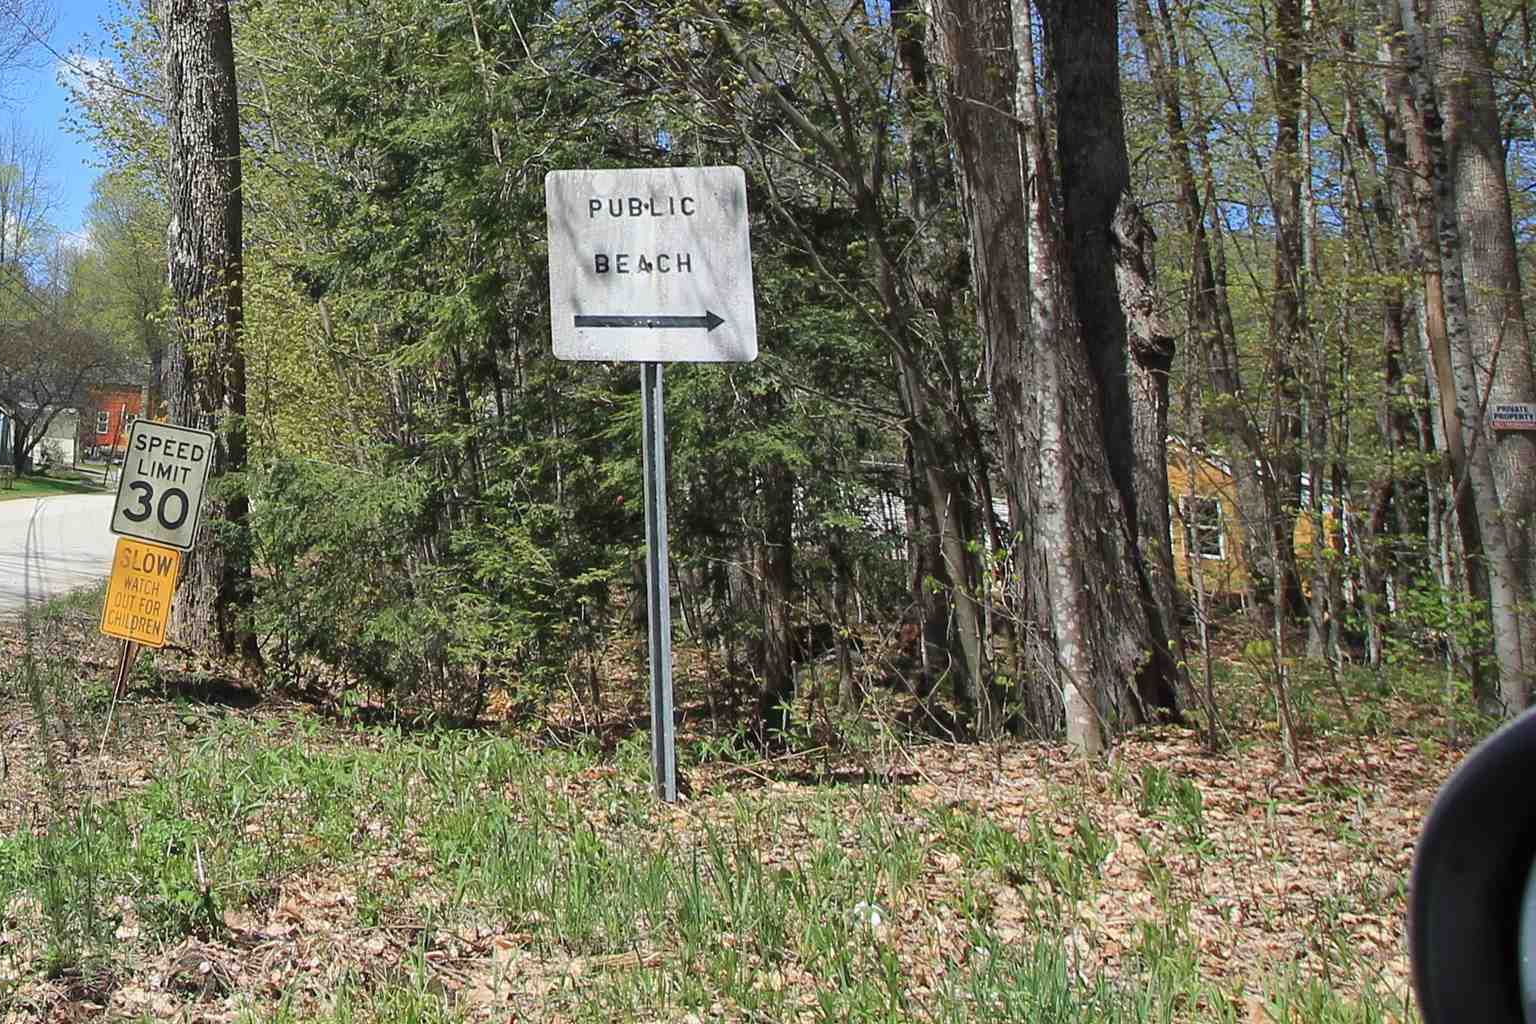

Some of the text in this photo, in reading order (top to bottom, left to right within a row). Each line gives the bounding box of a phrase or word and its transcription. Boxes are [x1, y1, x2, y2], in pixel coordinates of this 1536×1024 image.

[588, 196, 696, 218] PUBLIC
[594, 252, 693, 274] BEACH
[134, 433, 204, 462] SPEED
[137, 458, 192, 484] LIMIT
[122, 480, 190, 530] 30
[120, 547, 173, 577] SLOW
[124, 576, 160, 597] WATCH
[114, 592, 161, 616] OUT FOR
[108, 609, 162, 636] CHILDREN
